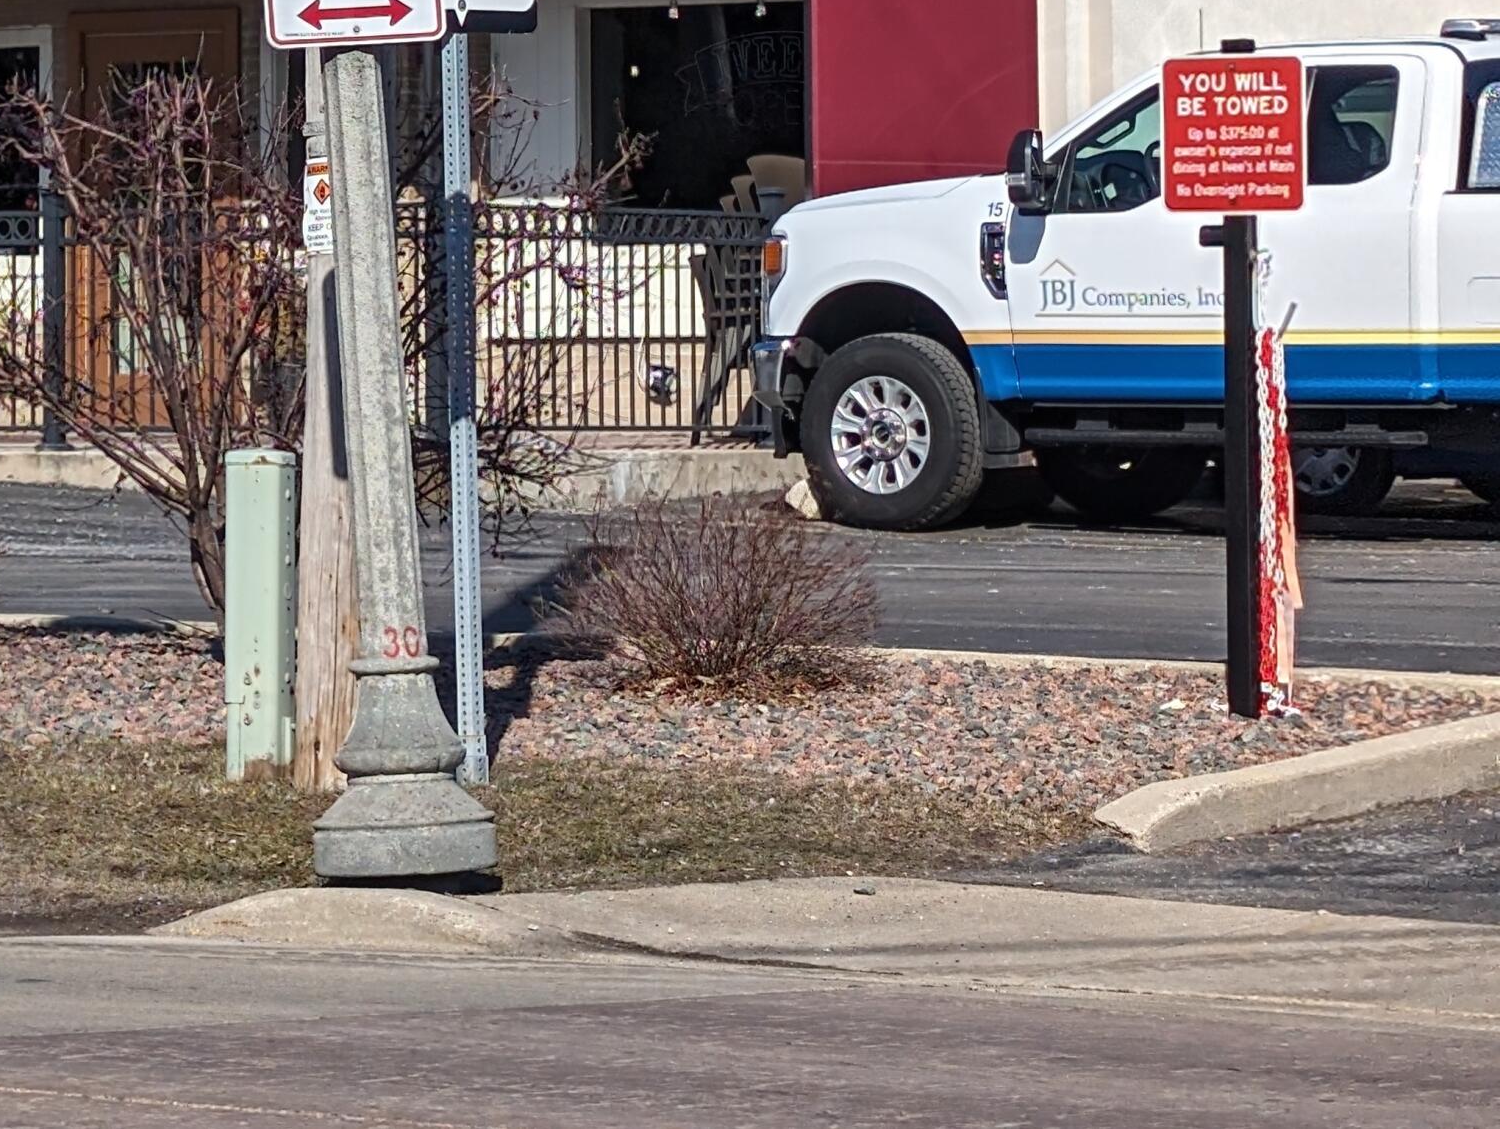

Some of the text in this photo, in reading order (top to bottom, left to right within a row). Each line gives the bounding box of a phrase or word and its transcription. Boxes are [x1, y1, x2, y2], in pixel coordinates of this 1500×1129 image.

[1178, 70, 1288, 94] YOU WILL
[1176, 95, 1289, 117] BE TOWED
[1188, 127, 1203, 142] Up
[1205, 127, 1217, 141] to
[1176, 181, 1291, 200] No Overnight Parking
[987, 202, 1004, 217] 15
[1040, 278, 1076, 312] JBJ
[1081, 287, 1191, 312] Companies,
[382, 625, 420, 659] 30
